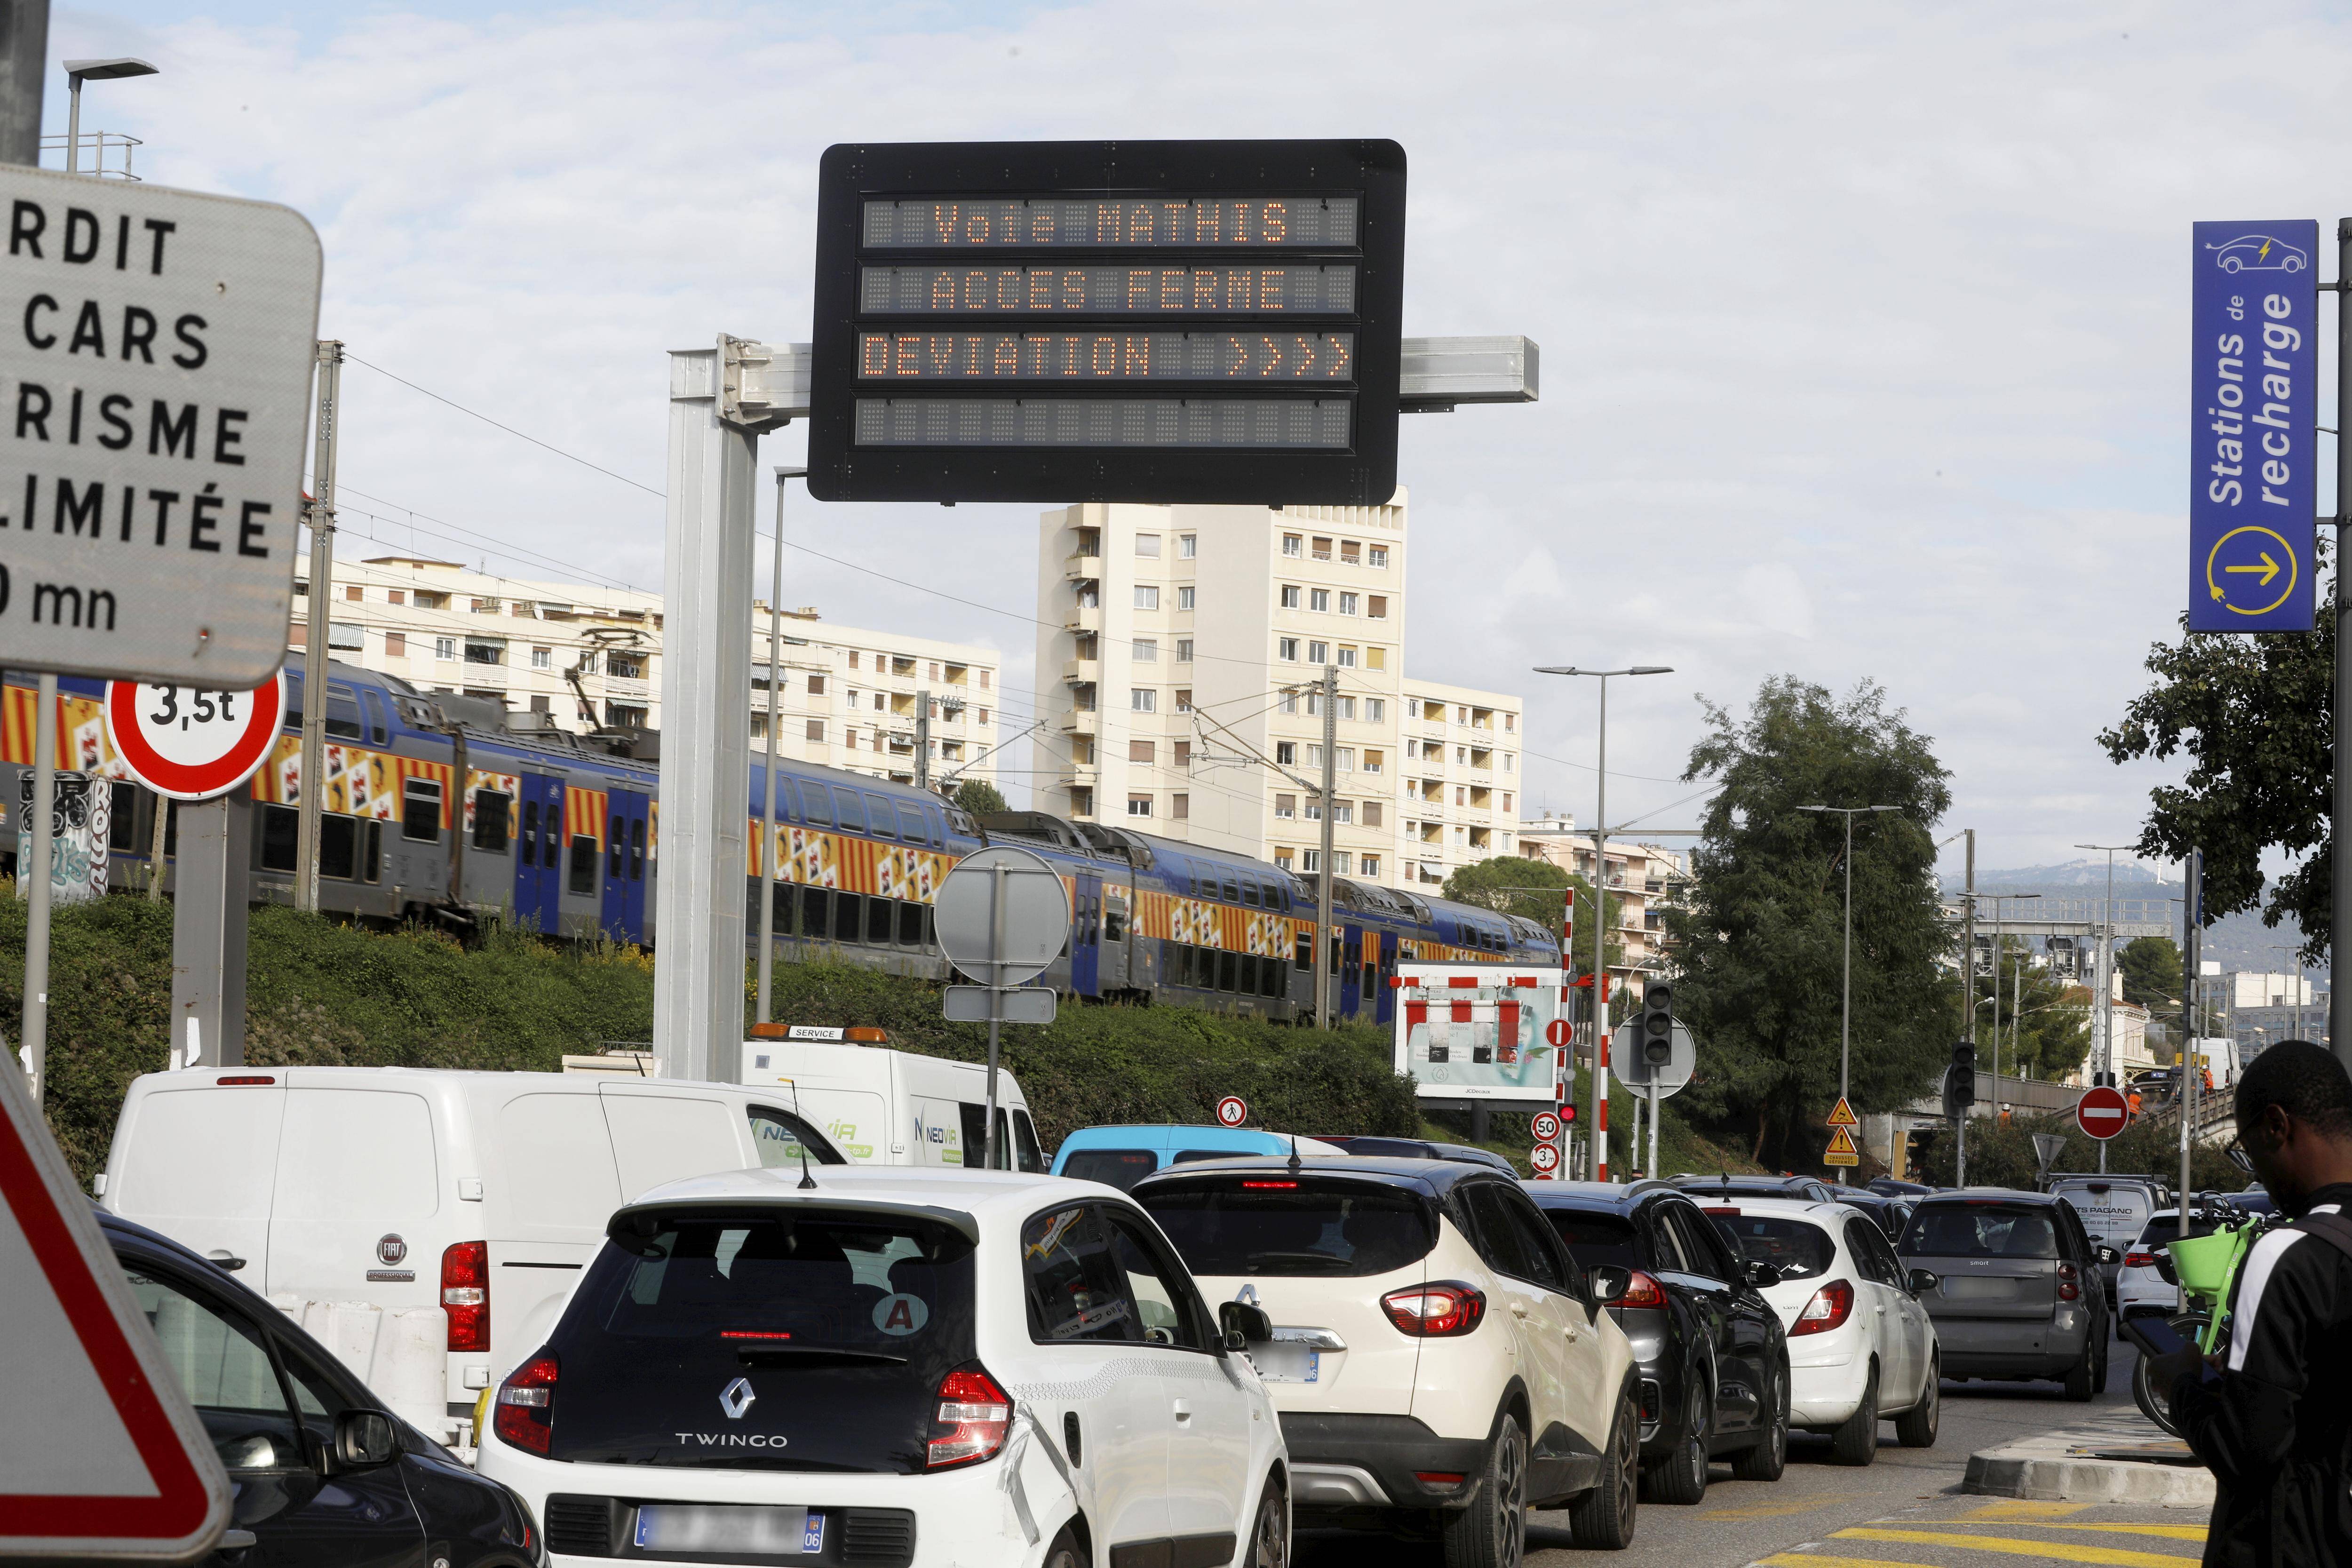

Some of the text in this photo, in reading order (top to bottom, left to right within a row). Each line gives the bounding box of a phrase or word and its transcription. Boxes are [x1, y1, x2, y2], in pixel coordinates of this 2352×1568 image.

[10, 199, 176, 275] RDIT
[935, 203, 1287, 244] Voie MATHIS
[932, 271, 1285, 309] ACCES FERME
[24, 294, 208, 370] CARS
[864, 336, 1150, 376] DEVIATION
[2209, 295, 2244, 507] Stations de
[2252, 294, 2302, 507] recharge
[16, 382, 249, 466] RISME
[33, 582, 116, 631] mn
[796, 1029, 834, 1038] SERVICE
[1538, 1121, 1554, 1133] 50
[383, 1242, 401, 1257] FIAT
[884, 1299, 913, 1329] A
[675, 1433, 788, 1448] TWINGO
[804, 1533, 820, 1547] 06
